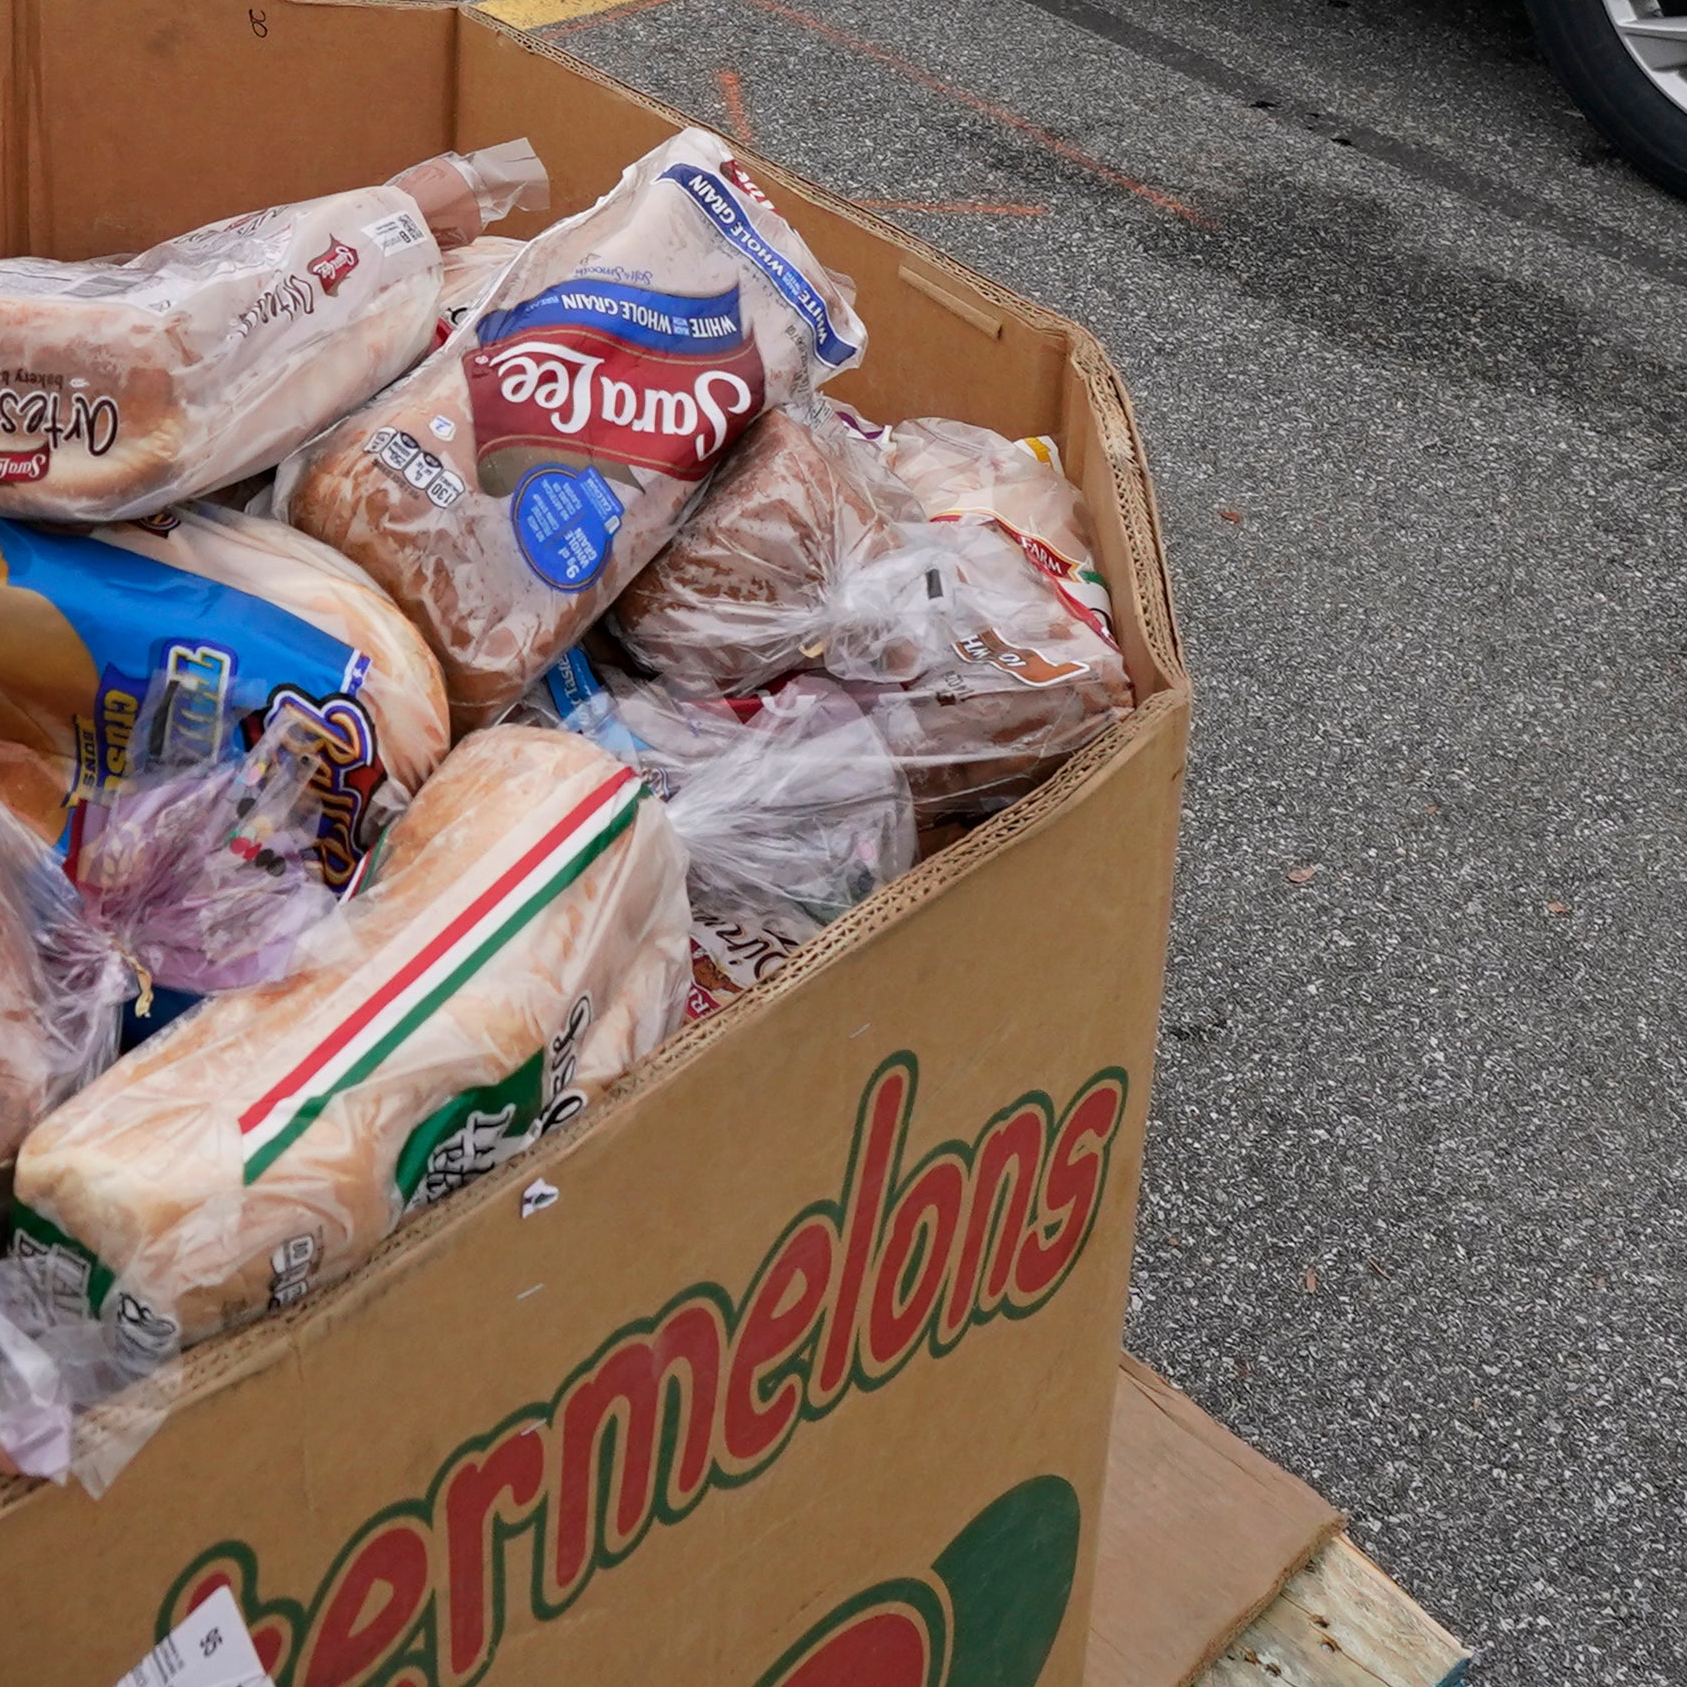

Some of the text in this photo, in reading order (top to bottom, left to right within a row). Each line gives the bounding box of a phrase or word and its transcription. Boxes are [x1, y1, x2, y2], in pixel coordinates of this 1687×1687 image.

[686, 172, 740, 226] GRAIN
[729, 220, 788, 279] WHOLE
[561, 294, 617, 313] GRAIN
[619, 300, 670, 335] WHOLE
[689, 314, 735, 337] WHITE
[14, 366, 64, 392] bakery
[488, 343, 750, 461] Sara Lee
[7, 452, 42, 477] Sara
[430, 482, 454, 505] 130
[563, 530, 590, 568] WHOLE
[573, 526, 598, 561] GRAIN
[81, 731, 94, 786] BUNS
[159, 1050, 1127, 1687] ermelons
